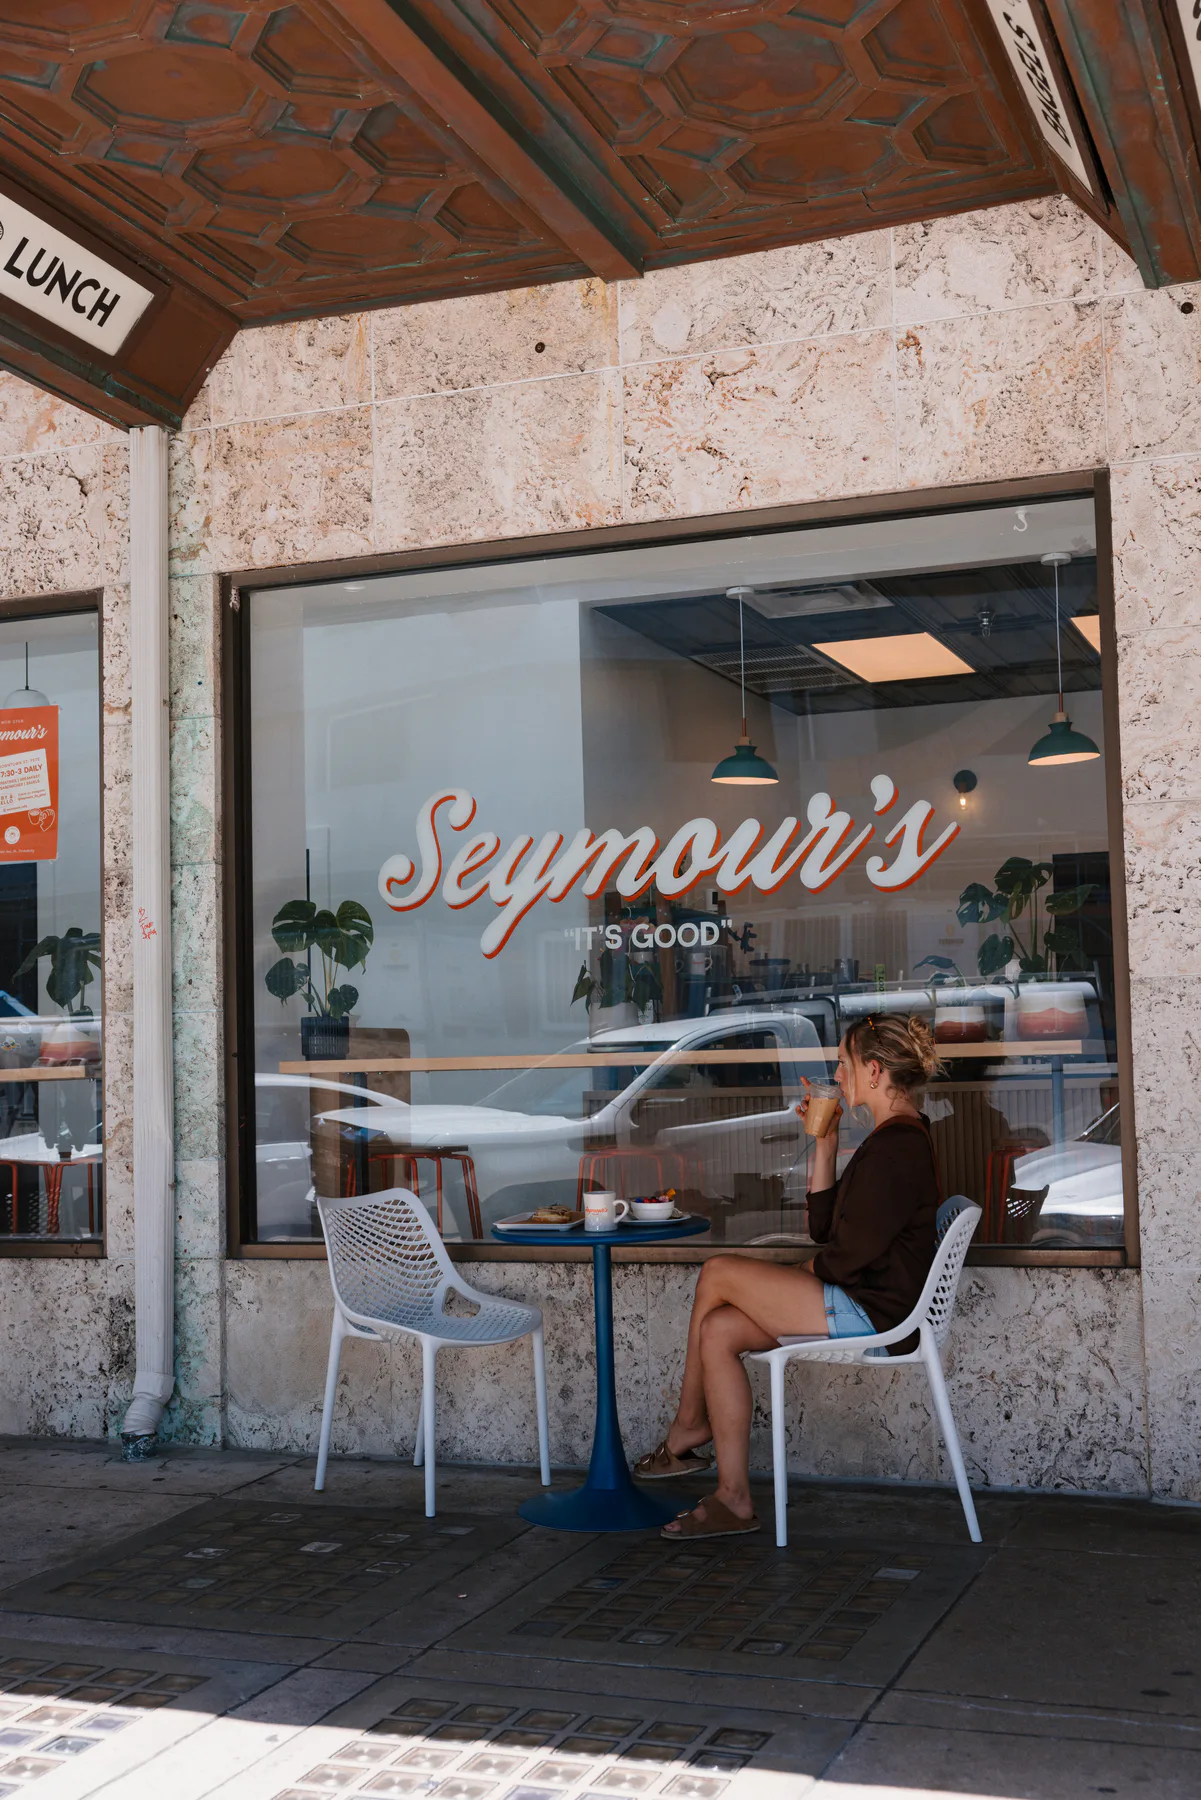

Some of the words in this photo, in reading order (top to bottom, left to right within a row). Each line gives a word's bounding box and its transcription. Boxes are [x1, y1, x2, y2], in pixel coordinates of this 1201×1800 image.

[1003, 11, 1072, 149] BAGELS
[3, 236, 121, 328] LUNCH
[0, 724, 48, 740] mour's
[0, 760, 22, 769] OWNTOWN
[1, 767, 22, 778] 7:30-3
[24, 764, 43, 774] DAILY
[378, 774, 962, 959] Seymour's
[631, 919, 732, 949] GOOD"
